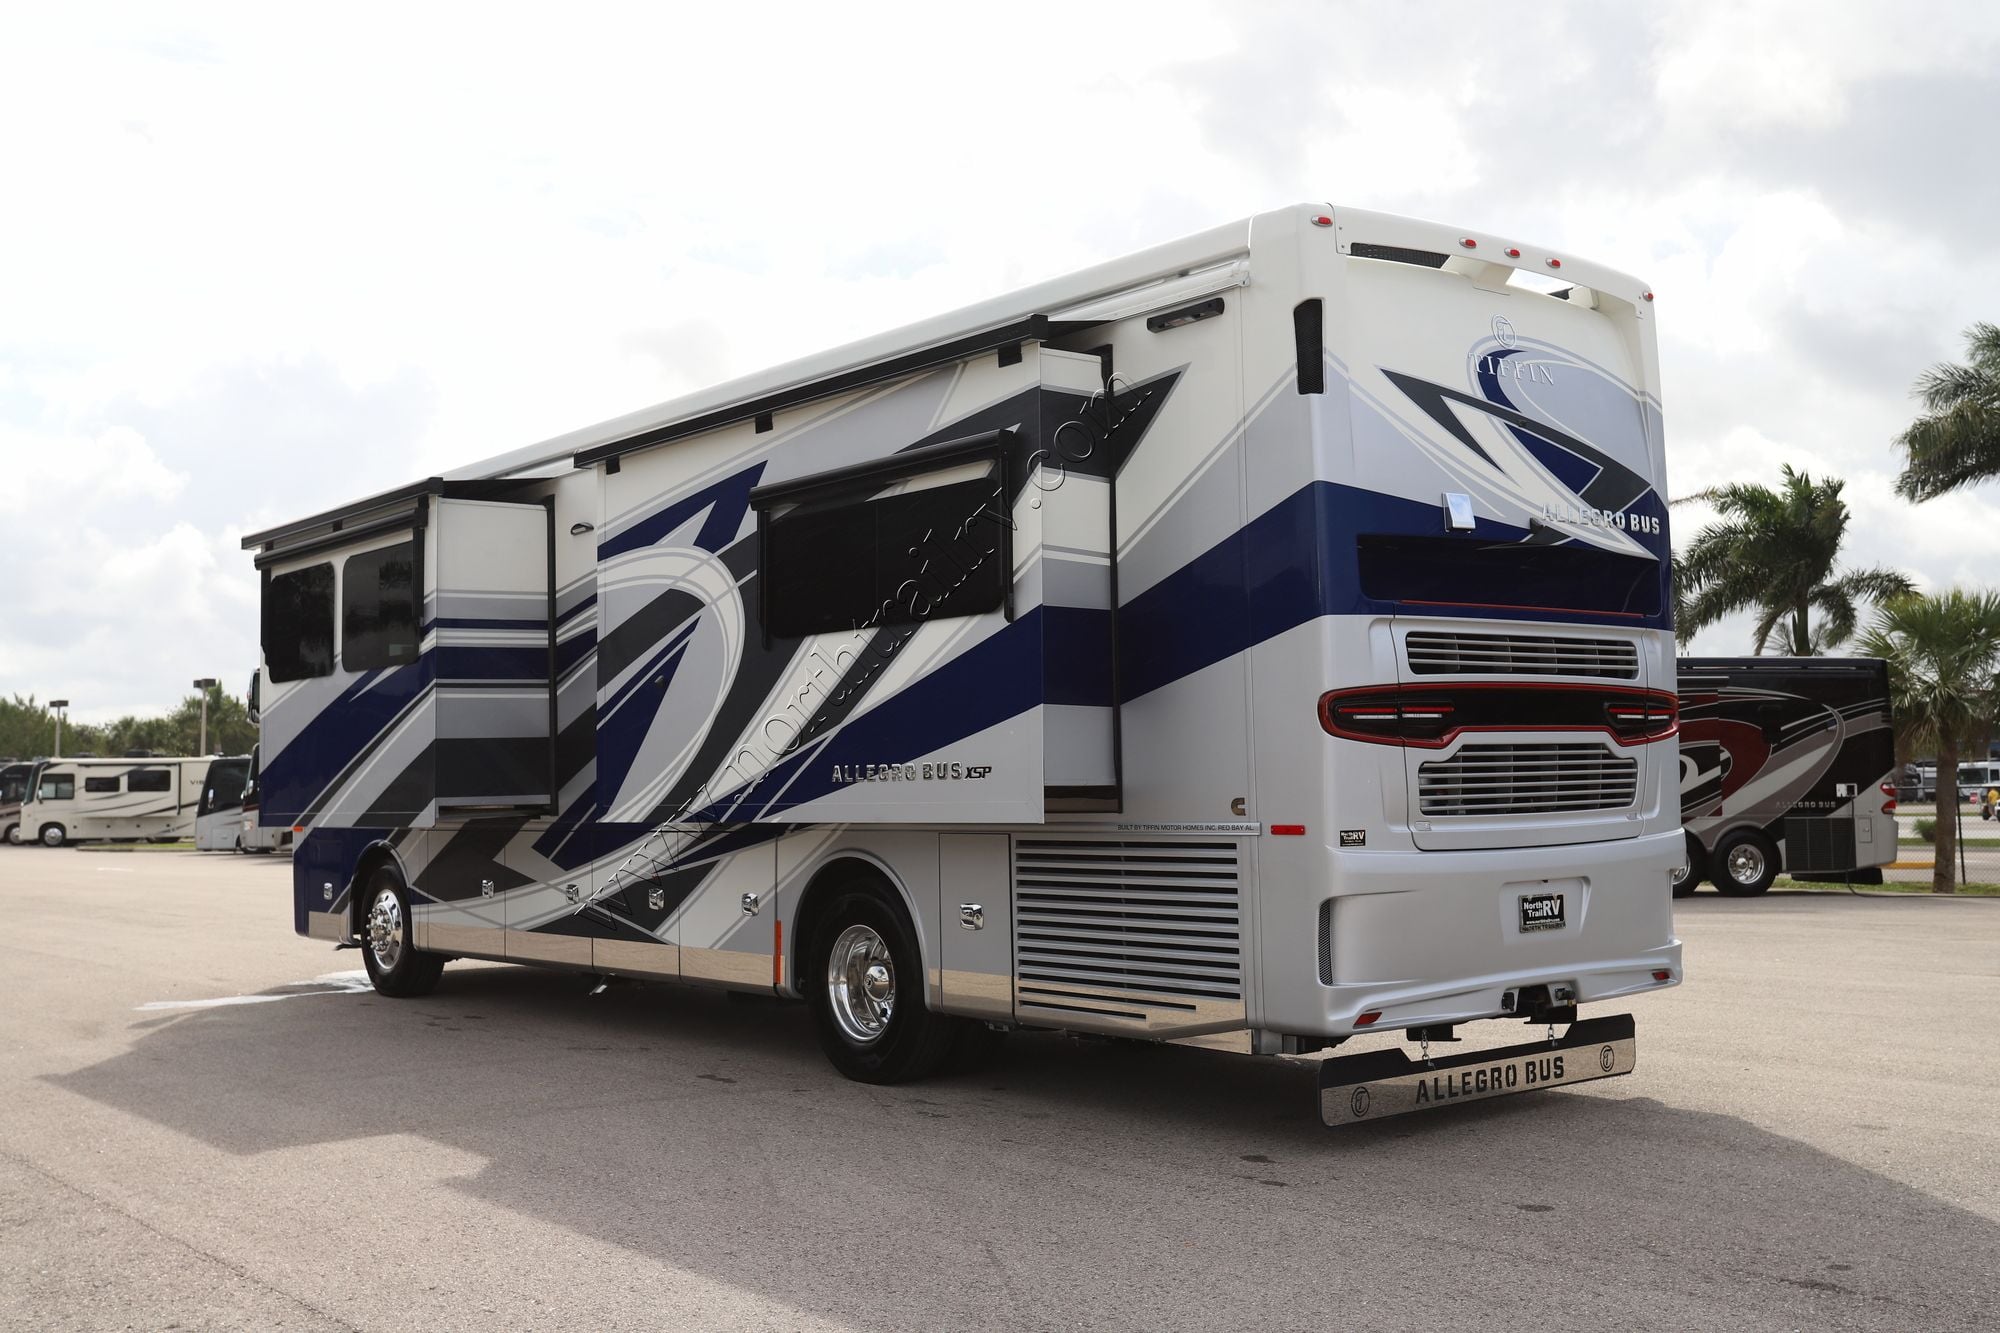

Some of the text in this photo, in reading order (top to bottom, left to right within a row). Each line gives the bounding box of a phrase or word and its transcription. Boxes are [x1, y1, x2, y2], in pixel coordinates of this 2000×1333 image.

[1468, 352, 1554, 385] TIFFIN
[1542, 504, 1660, 535] ALLEGRO BUS
[831, 761, 992, 783] ALLEGRO BUS XSP
[1523, 901, 1543, 910] North
[1528, 909, 1543, 917] Trail
[1543, 900, 1560, 916] RV
[1415, 1065, 1517, 1104] ALLEGRO
[1525, 1056, 1565, 1084] BUS
